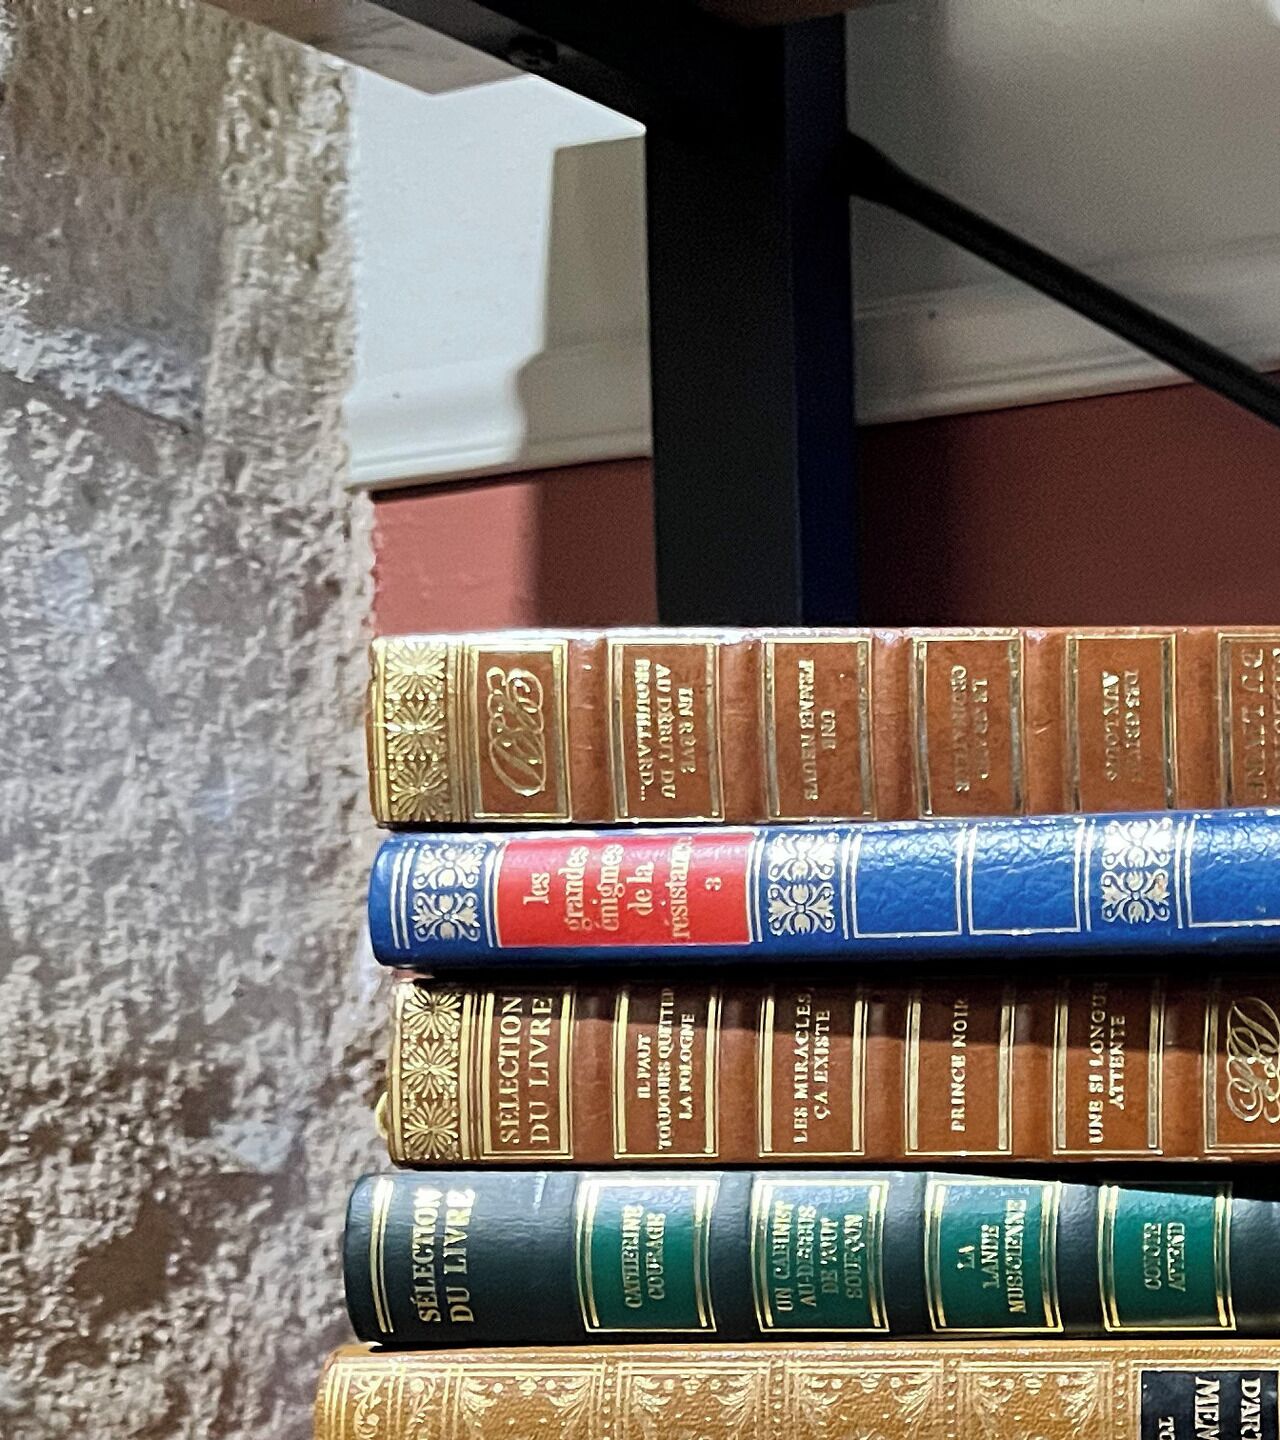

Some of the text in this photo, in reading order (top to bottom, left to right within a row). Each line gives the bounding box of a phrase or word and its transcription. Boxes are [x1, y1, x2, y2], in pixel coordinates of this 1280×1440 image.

[655, 664, 671, 692] AU
[678, 688, 694, 717] UN
[972, 678, 988, 703] LE
[1102, 672, 1119, 715] AUX
[1124, 671, 1140, 708] DES
[1241, 649, 1263, 693] DU
[821, 710, 835, 749] UNE
[661, 770, 675, 799] DU
[801, 735, 818, 800] NEUVE
[523, 872, 550, 905] les
[558, 846, 593, 931] grandes
[592, 843, 625, 931] énigmes
[626, 862, 654, 915] de la
[705, 876, 721, 890] 3
[496, 996, 523, 1143] SÉLECTION
[529, 998, 553, 1143] DU LIVRE
[637, 1033, 651, 1098] IL FAUT
[679, 1013, 695, 1119] LA POLOGNE
[814, 1010, 830, 1119] ÇA EXISTE
[951, 998, 969, 1132] PRINCE NOIR
[1088, 982, 1108, 1144] UNE SI LONGUE
[1109, 1015, 1125, 1110] ATTENTE
[657, 1061, 672, 1149] TOUJOURS
[793, 1107, 809, 1143] LES
[410, 1187, 443, 1322] SÉLECTION
[443, 1189, 476, 1322] DU LIVRE
[622, 1205, 644, 1308] CATHERINE
[645, 1212, 666, 1300] COURAGE
[772, 1200, 794, 1312] UN CABINET
[821, 1270, 839, 1293] DE
[957, 1245, 975, 1269] LA
[980, 1225, 1001, 1288] LANDE
[1005, 1198, 1027, 1312] MUSICIENNE
[1167, 1222, 1185, 1291] ATTEND
